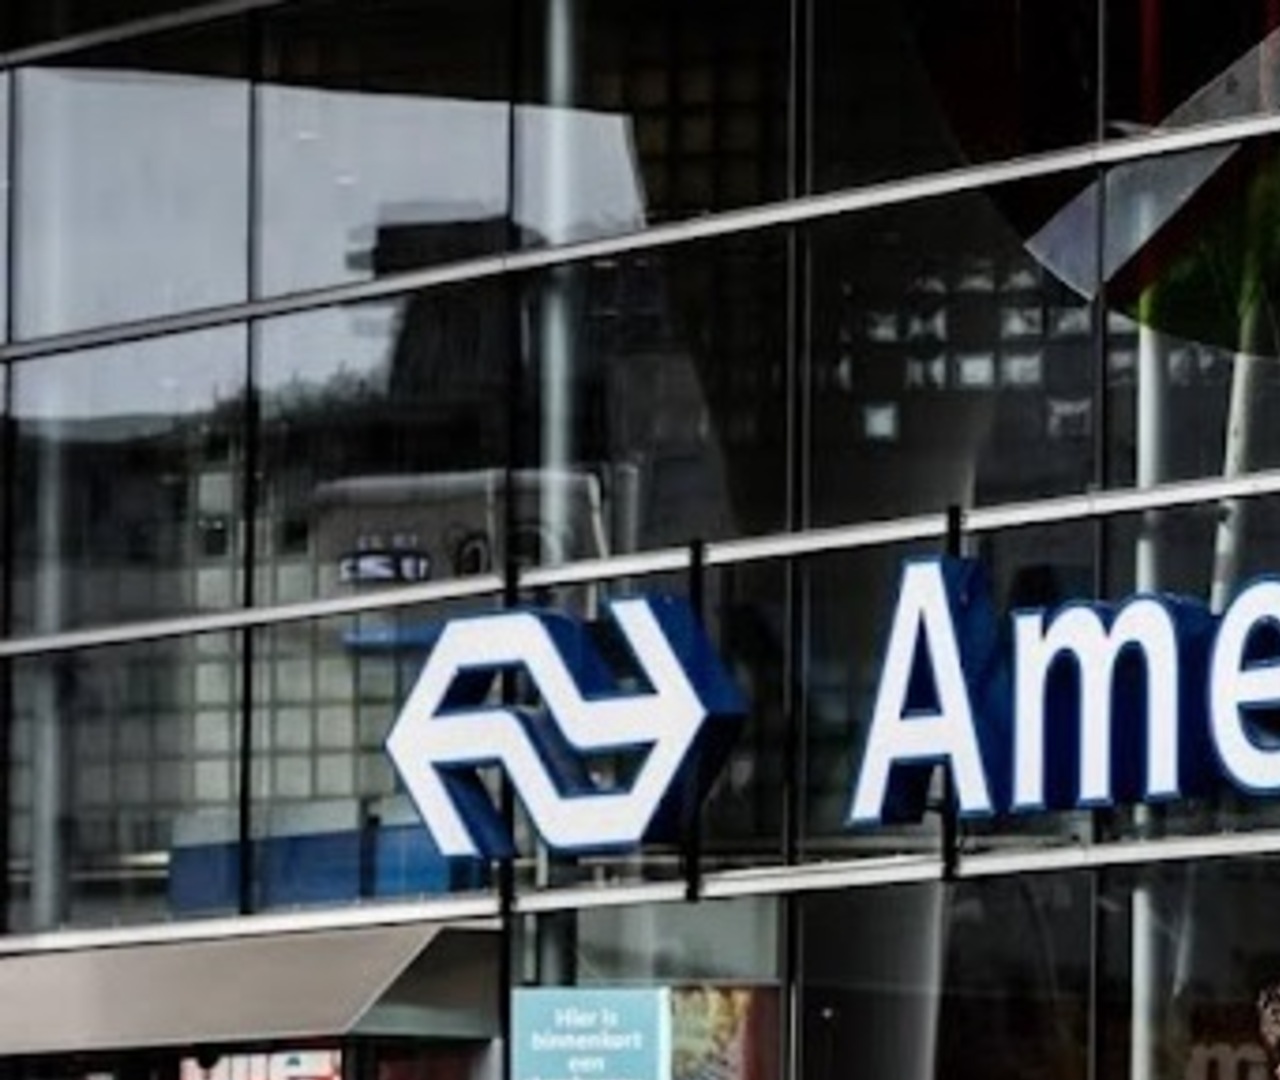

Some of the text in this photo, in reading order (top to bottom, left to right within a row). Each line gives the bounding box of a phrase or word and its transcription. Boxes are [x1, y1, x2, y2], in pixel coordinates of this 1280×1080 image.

[554, 1006, 619, 1027] Hier is
[531, 1030, 643, 1051] binnenkort
[568, 1057, 605, 1073] een
